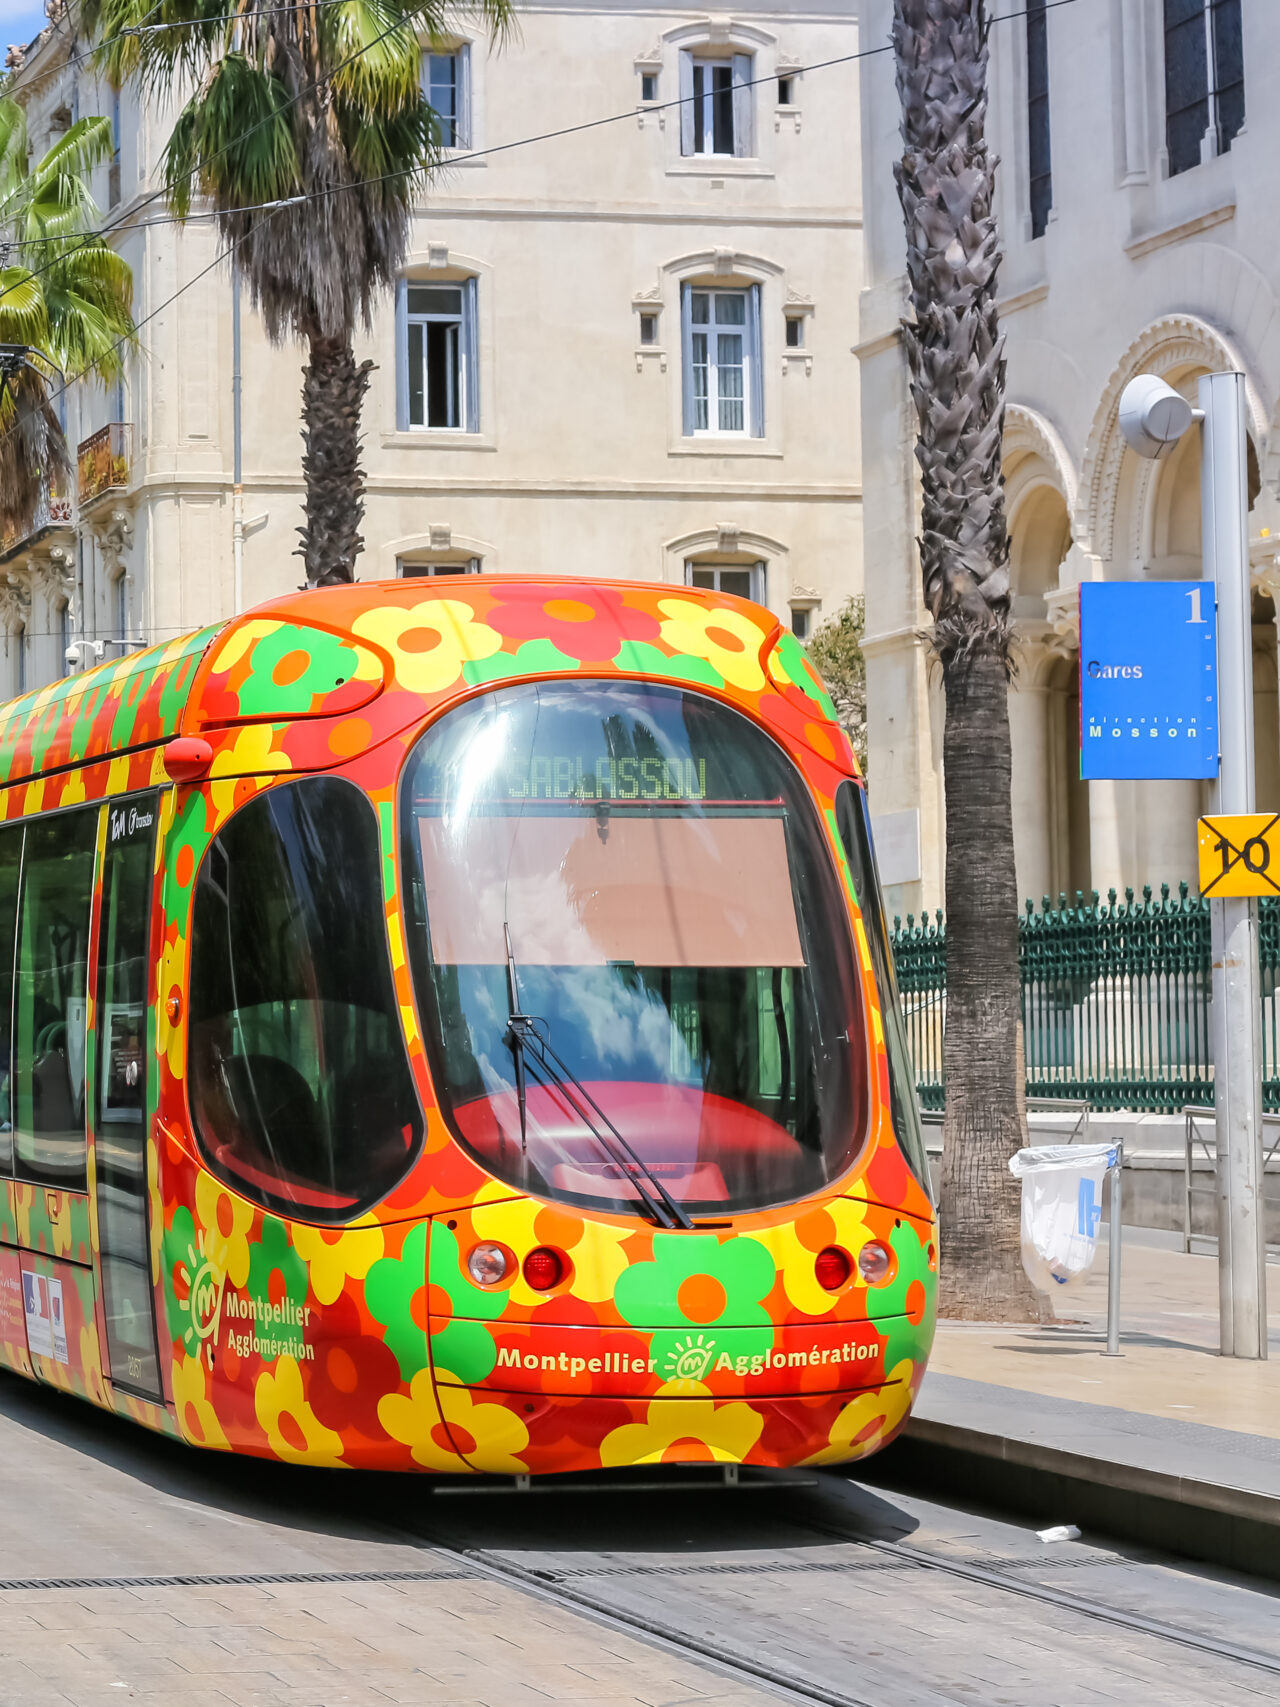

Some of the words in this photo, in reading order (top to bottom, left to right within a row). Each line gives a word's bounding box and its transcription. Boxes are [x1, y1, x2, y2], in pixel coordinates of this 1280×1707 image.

[1184, 587, 1208, 623] 1
[1087, 660, 1143, 679] Gares
[1089, 725, 1197, 738] Mosson
[507, 755, 707, 799] SABLASSOU
[1213, 836, 1271, 875] 10
[226, 1291, 311, 1330] Montpellier
[227, 1328, 316, 1360] Agglomération
[496, 1347, 658, 1377] Montpellier
[714, 1340, 881, 1376] Agglomération
